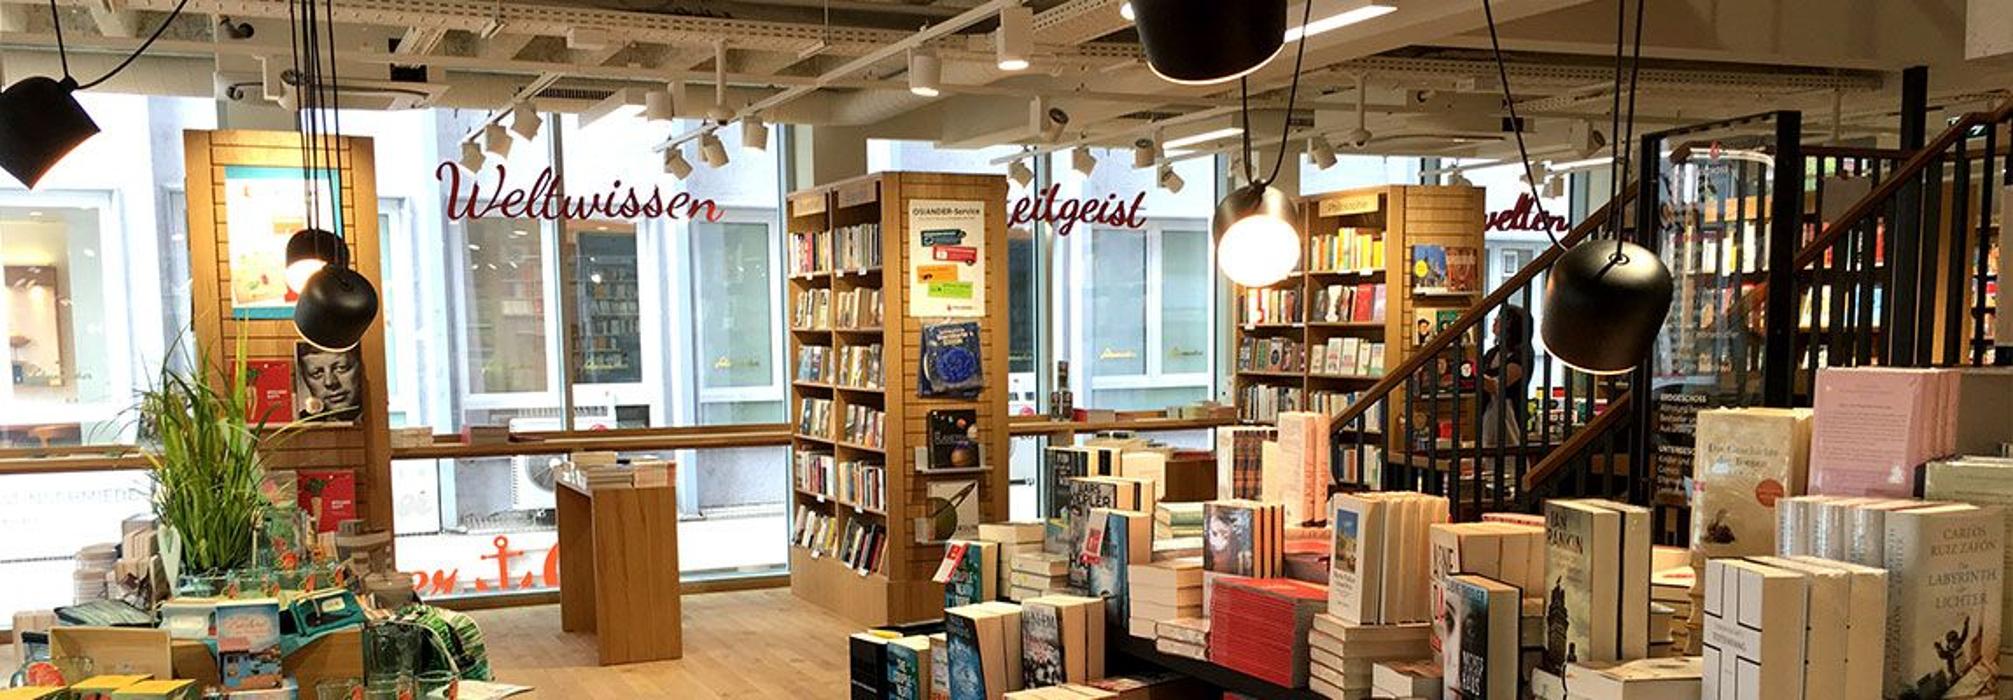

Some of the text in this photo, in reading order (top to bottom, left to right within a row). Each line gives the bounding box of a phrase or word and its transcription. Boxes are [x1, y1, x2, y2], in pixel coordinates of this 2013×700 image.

[436, 161, 726, 222] Weltwissen
[1008, 183, 1147, 236] eitgeist
[1942, 526, 1987, 541] CARLOS
[1931, 543, 1957, 557] RUIZ
[1928, 569, 1998, 587] LABYRINTH
[1936, 592, 1988, 610] LICHTER
